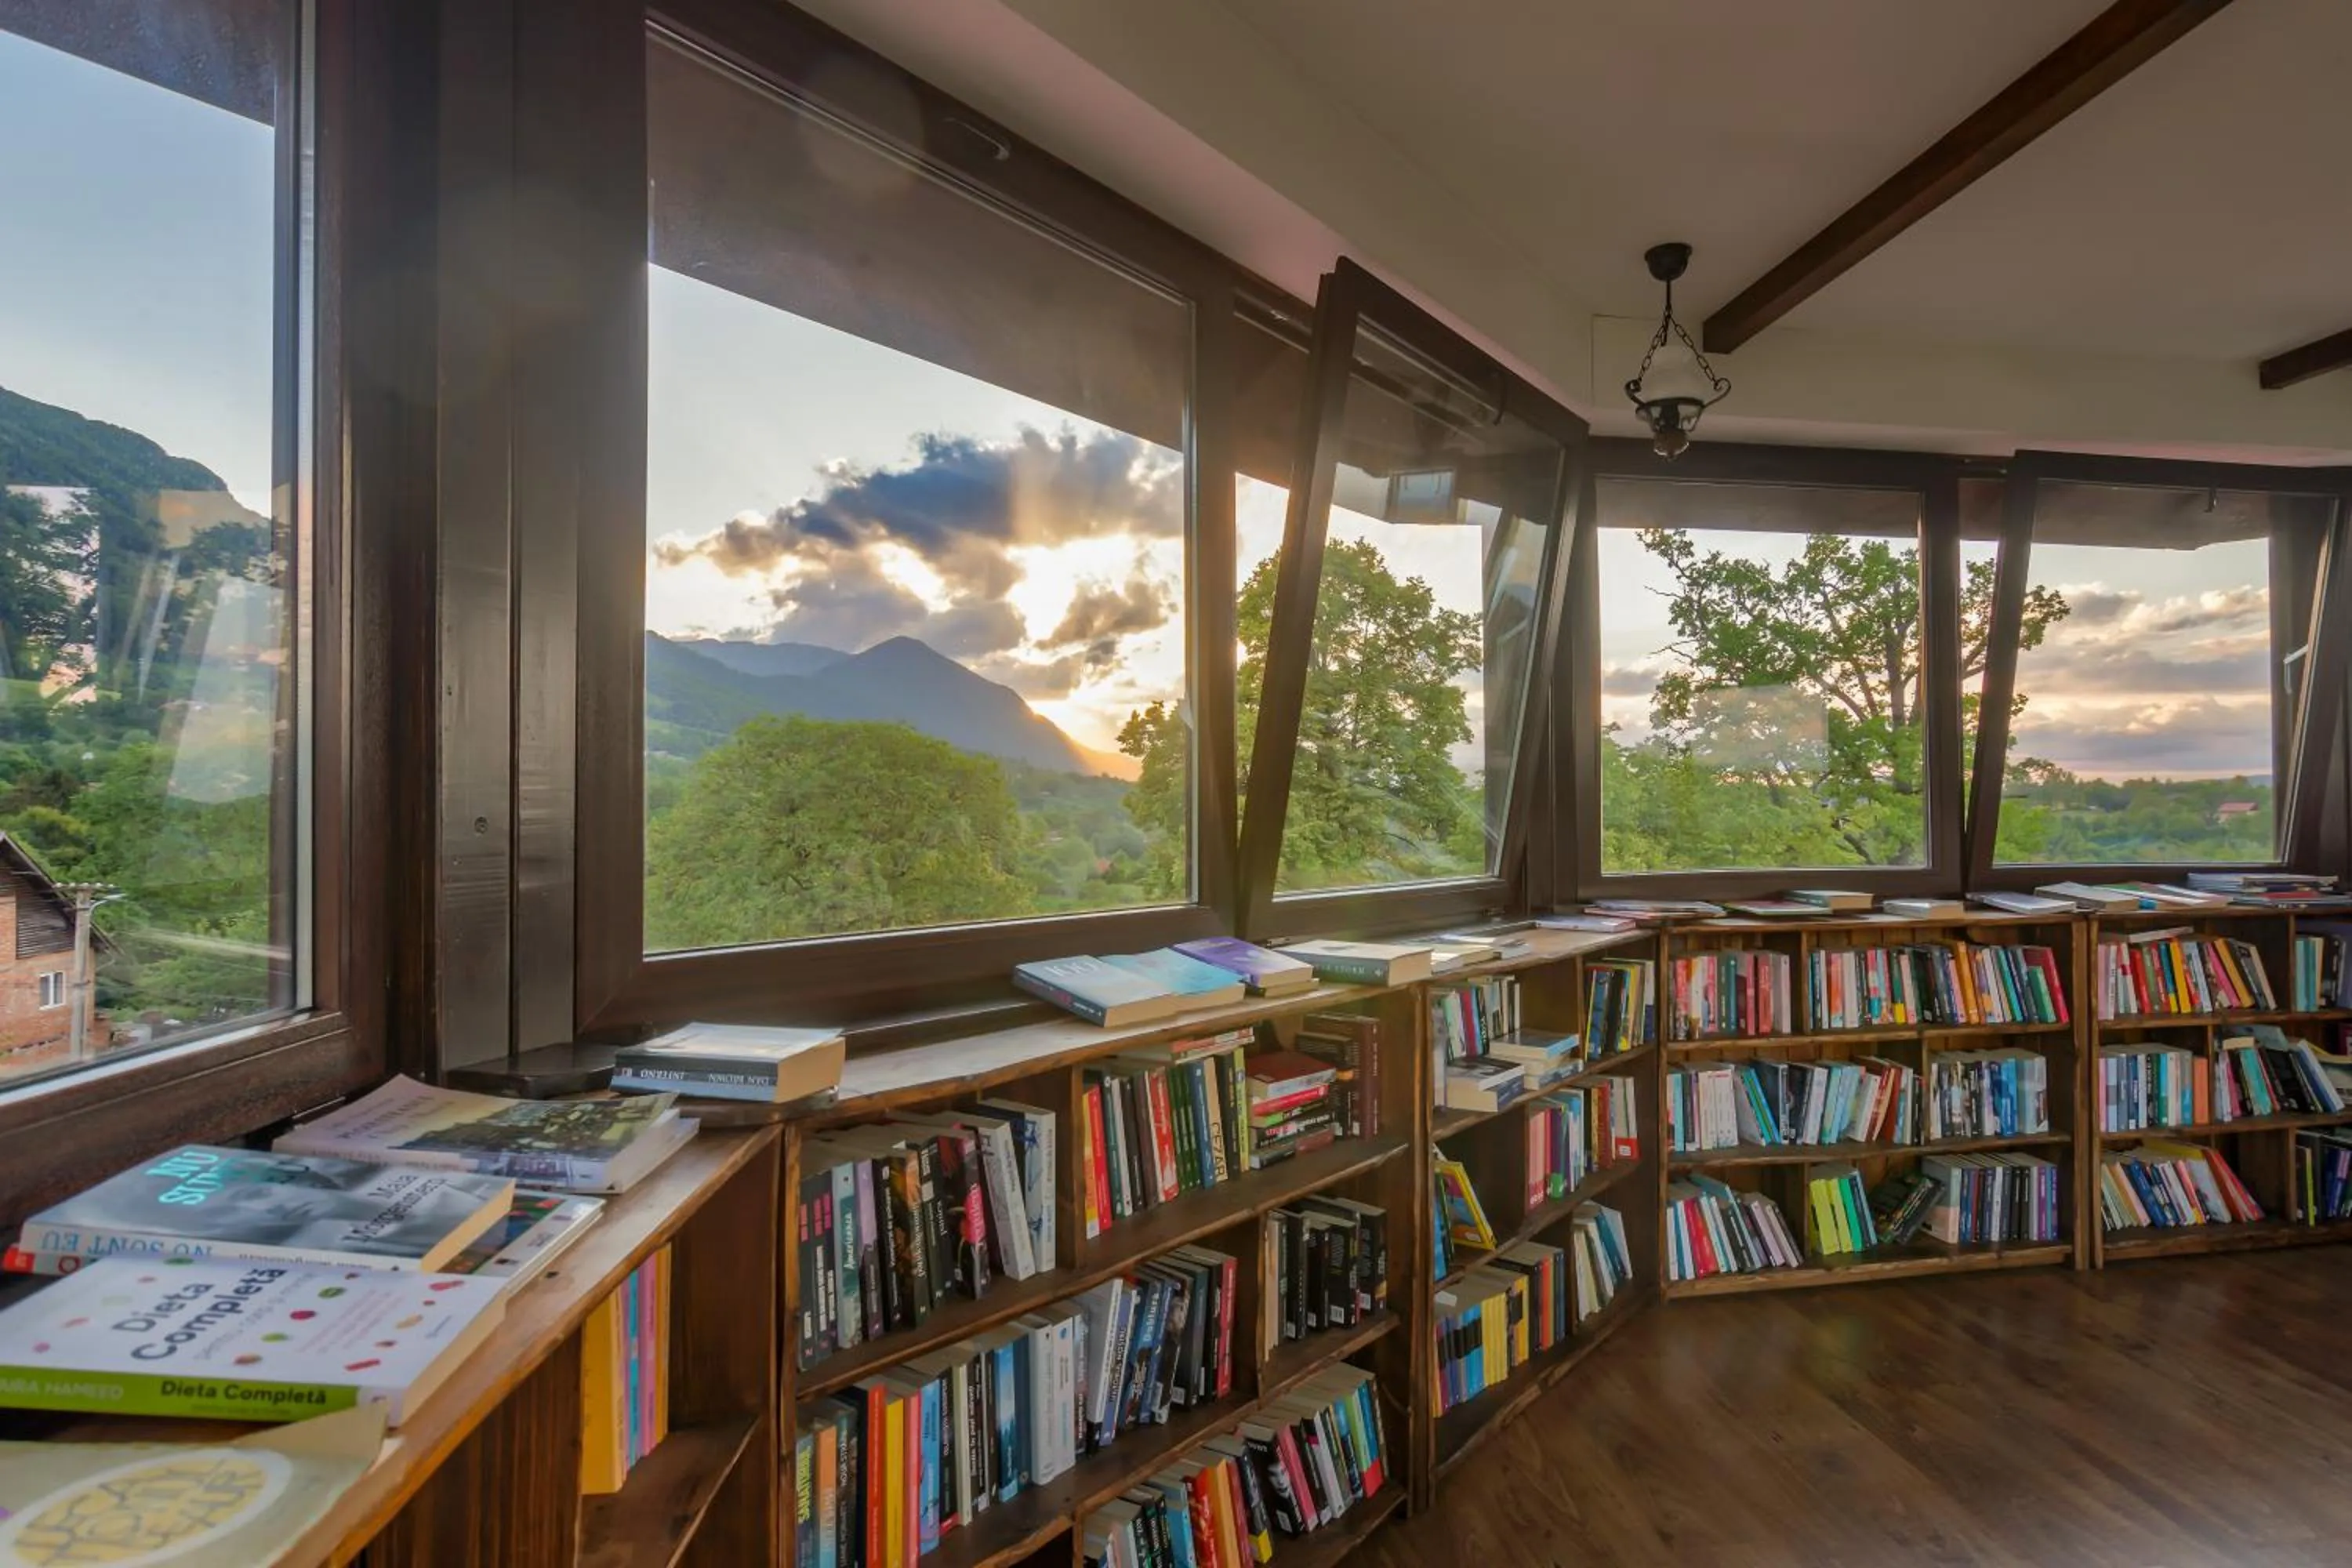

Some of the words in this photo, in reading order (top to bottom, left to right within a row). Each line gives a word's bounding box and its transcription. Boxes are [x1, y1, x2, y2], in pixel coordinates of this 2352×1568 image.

[640, 1068, 686, 1080] INFERNO
[1211, 1122, 1227, 1177] CEZAR
[145, 1151, 220, 1178] NU
[42, 1229, 79, 1254] EU
[111, 1283, 216, 1333] Dieta
[130, 1267, 288, 1361] Completă
[161, 1380, 218, 1399] Dieta
[223, 1383, 327, 1406] Completă
